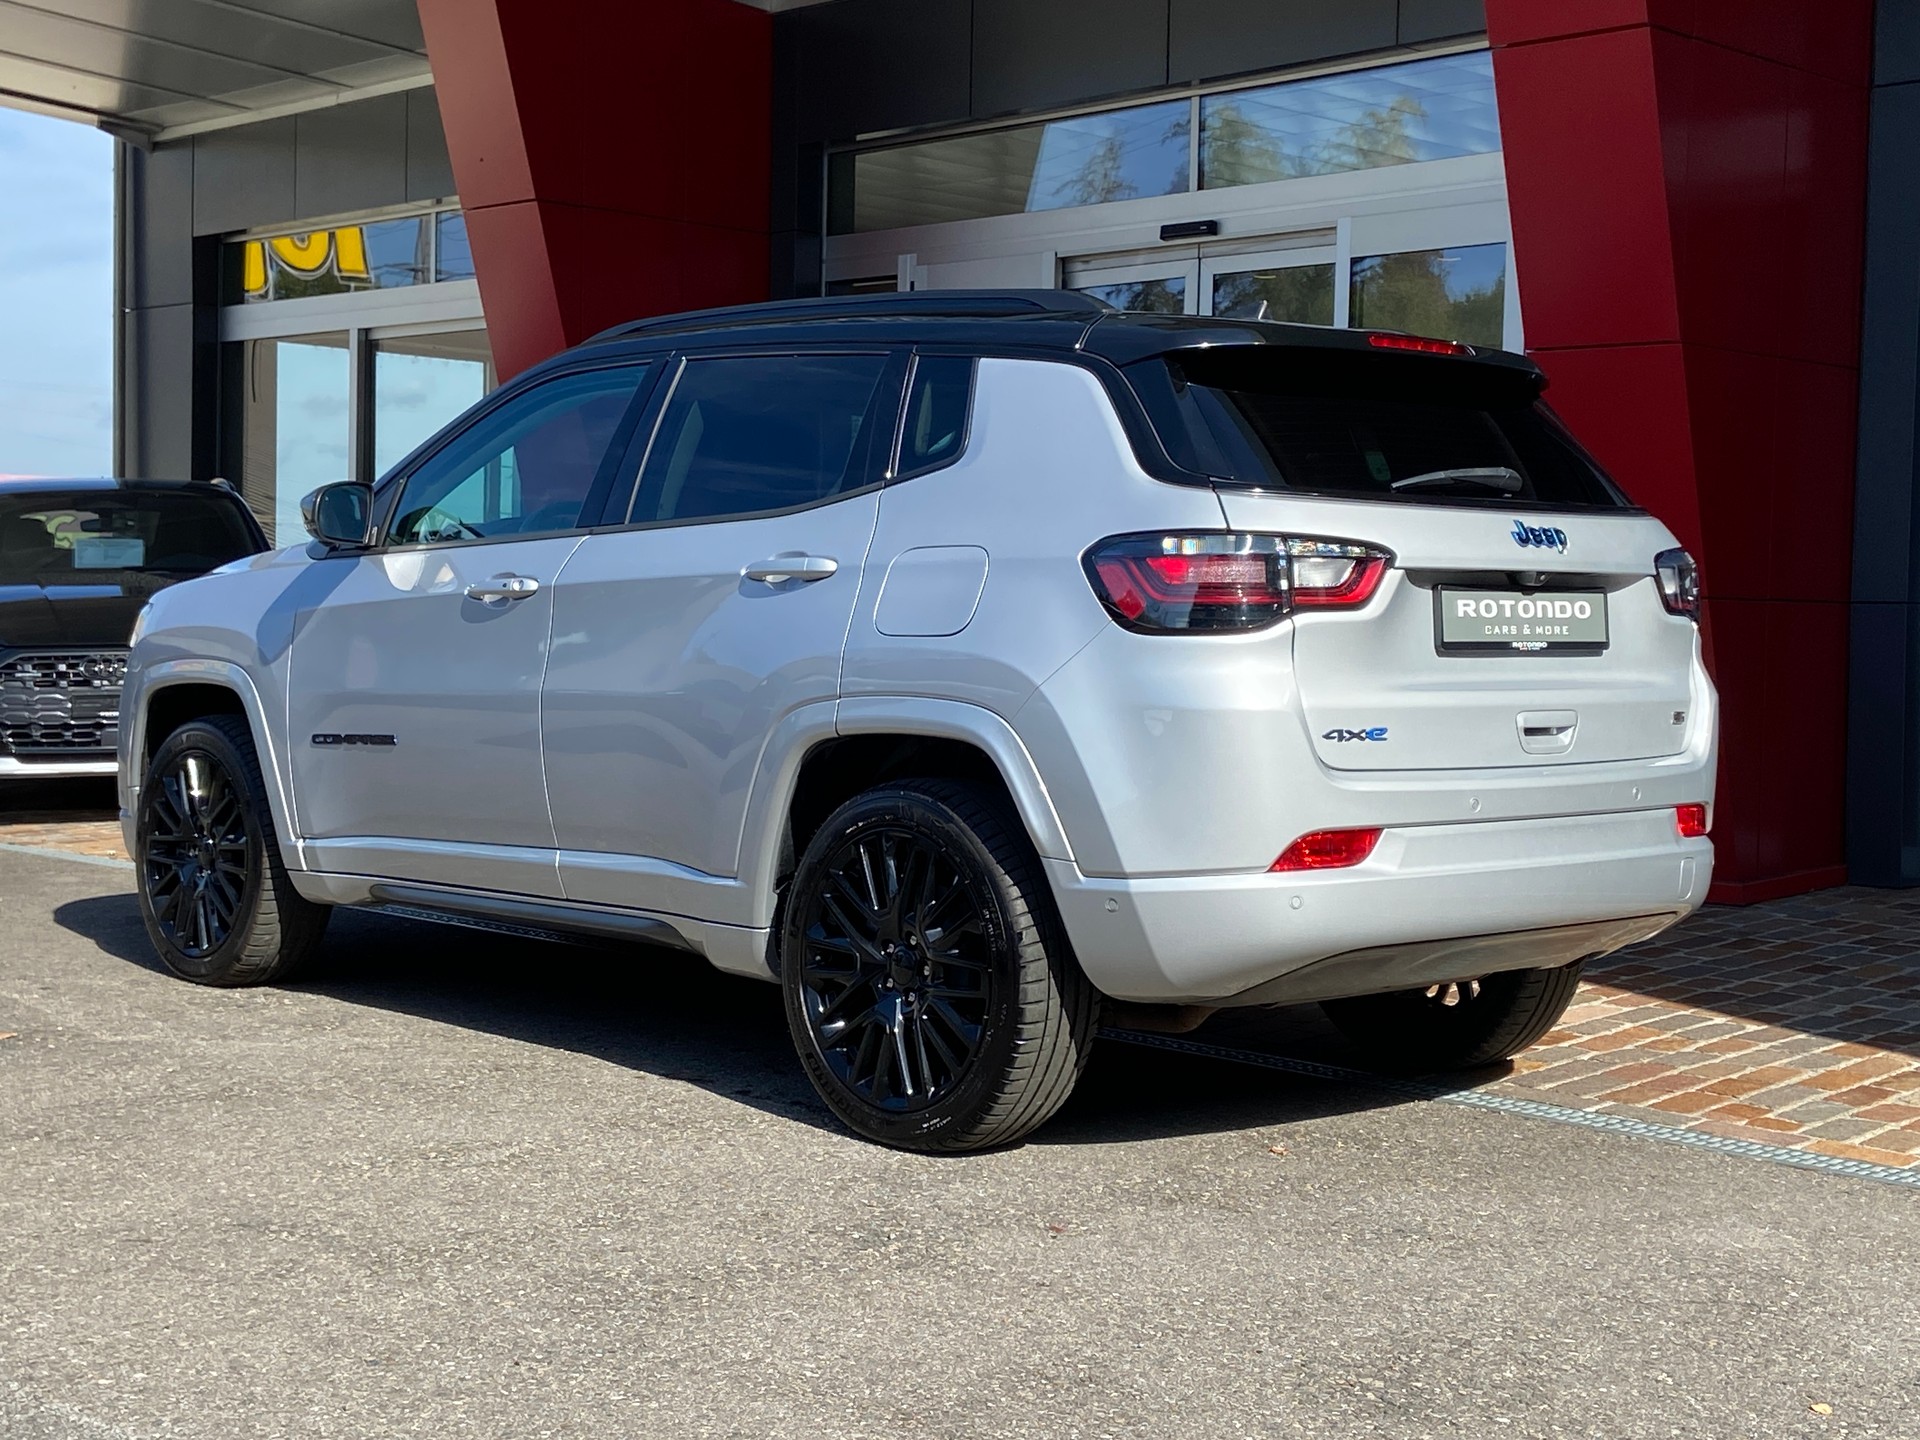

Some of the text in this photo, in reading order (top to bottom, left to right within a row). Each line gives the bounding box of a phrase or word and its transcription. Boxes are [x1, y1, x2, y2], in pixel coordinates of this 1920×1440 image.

[1510, 519, 1567, 554] Jeep
[1457, 599, 1592, 619] ROTONDO
[1484, 624, 1569, 636] CARS & MORE
